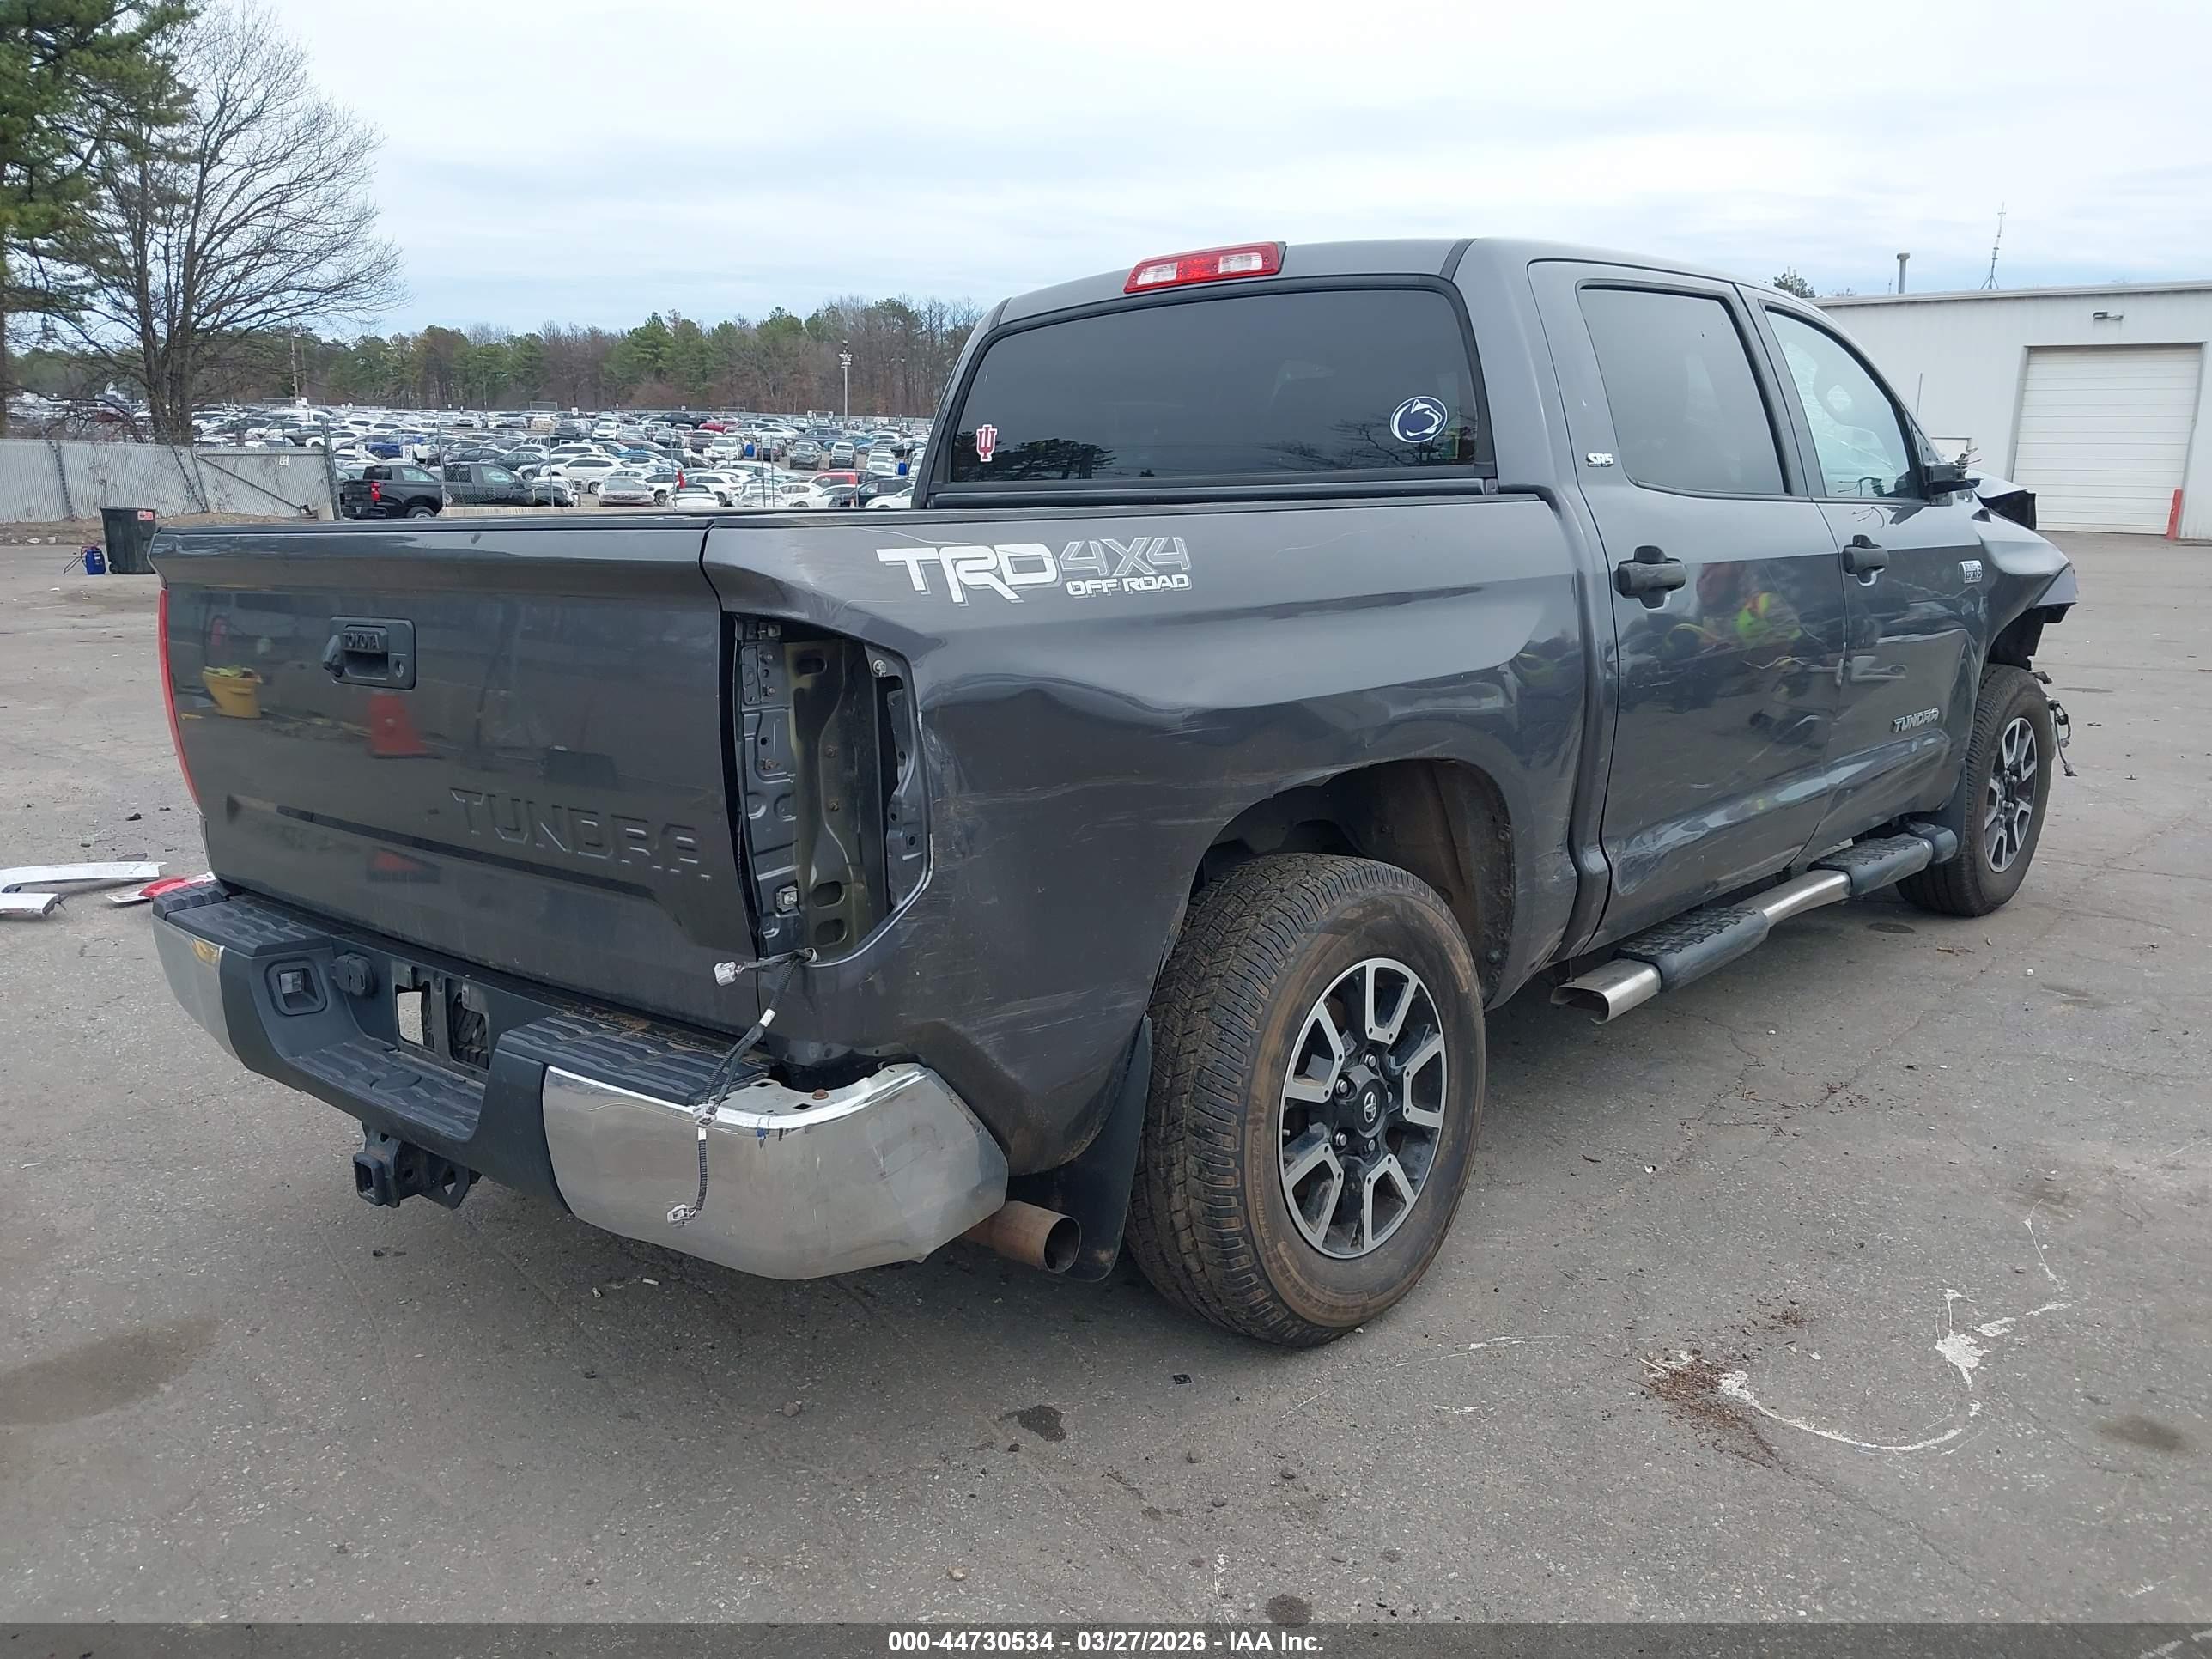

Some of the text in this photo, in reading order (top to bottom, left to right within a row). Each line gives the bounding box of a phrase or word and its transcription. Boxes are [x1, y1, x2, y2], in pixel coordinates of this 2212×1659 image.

[1587, 453, 1614, 467] SR5
[876, 543, 1060, 606] TRD
[1066, 574, 1192, 599] OFF ROAD
[343, 632, 380, 650] TOYOTA
[1893, 708, 1940, 732] TUNDRA
[448, 787, 713, 880] TUNDRA
